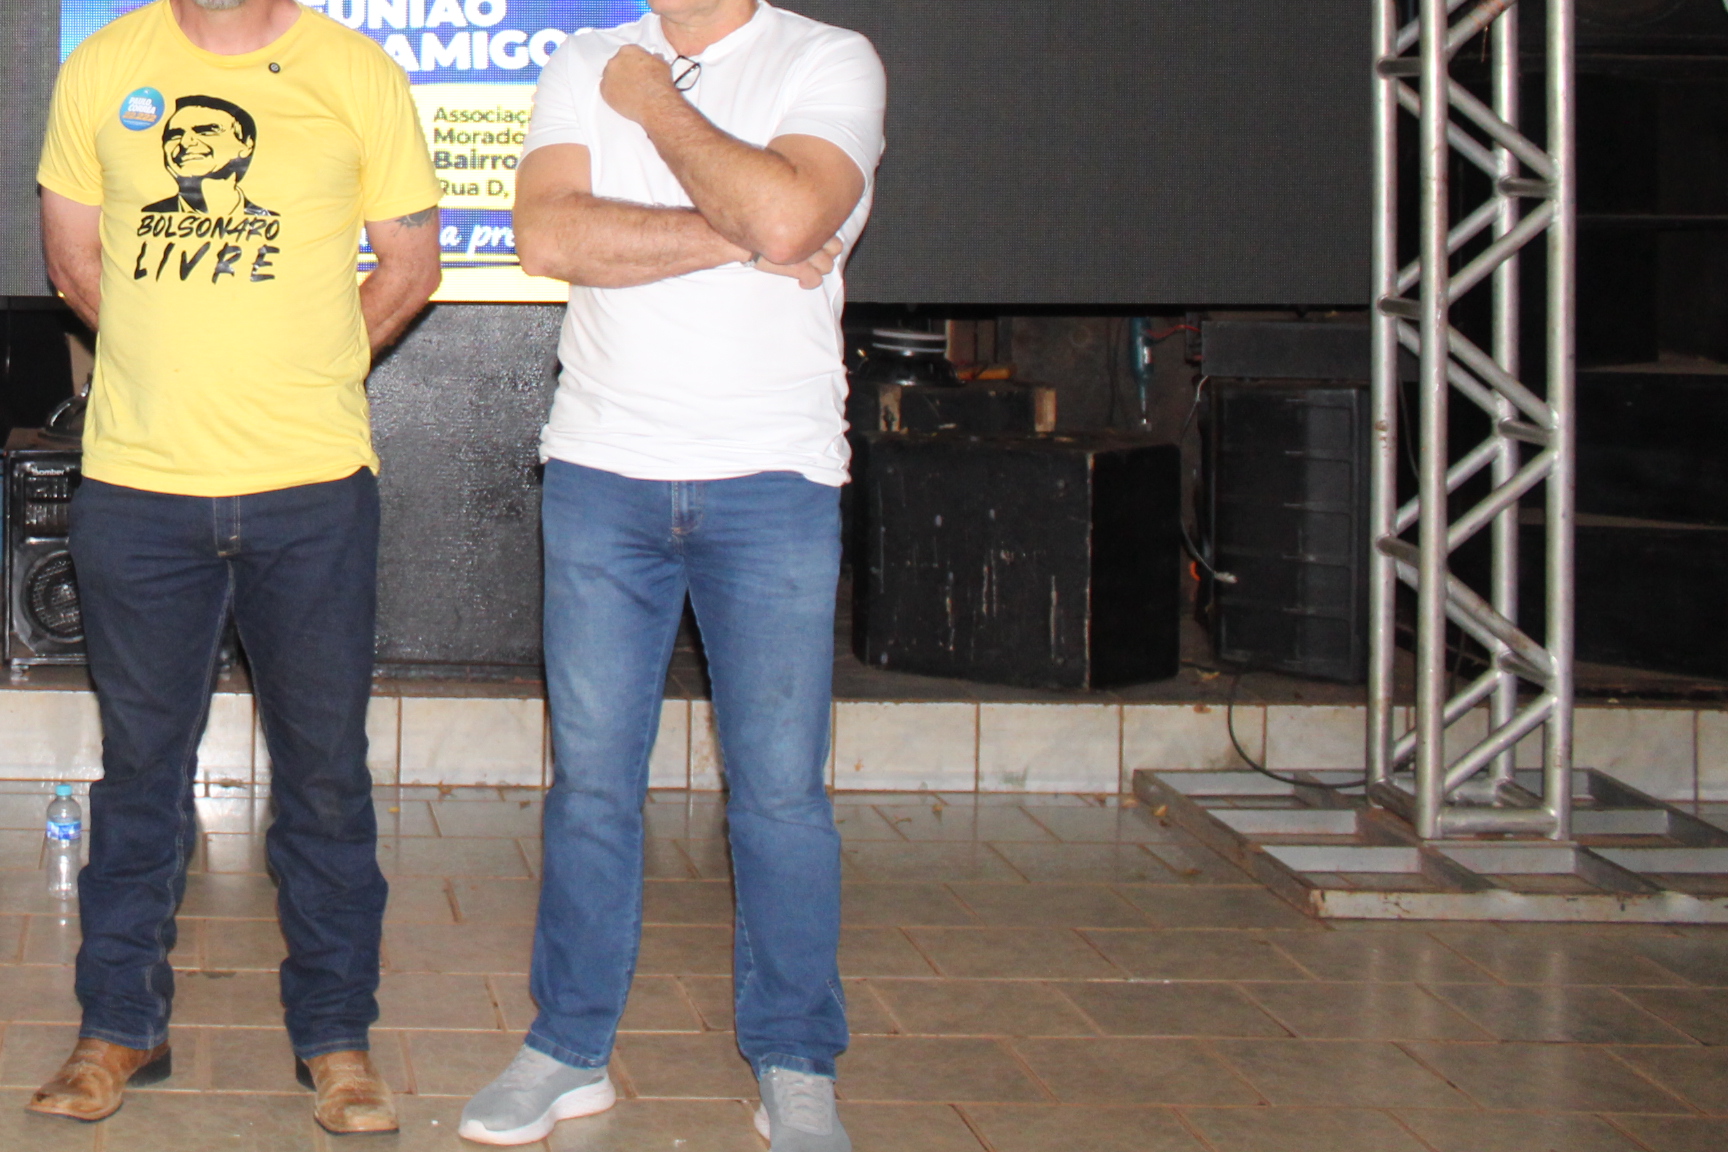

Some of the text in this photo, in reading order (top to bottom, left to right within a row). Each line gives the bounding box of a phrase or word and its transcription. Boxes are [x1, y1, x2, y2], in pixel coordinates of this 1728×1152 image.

[383, 27, 594, 72] AMIGO
[434, 105, 531, 127] Associaç
[434, 149, 518, 169] Bairro
[137, 214, 280, 242] BOLSONARO
[134, 241, 280, 285] LIVRE
